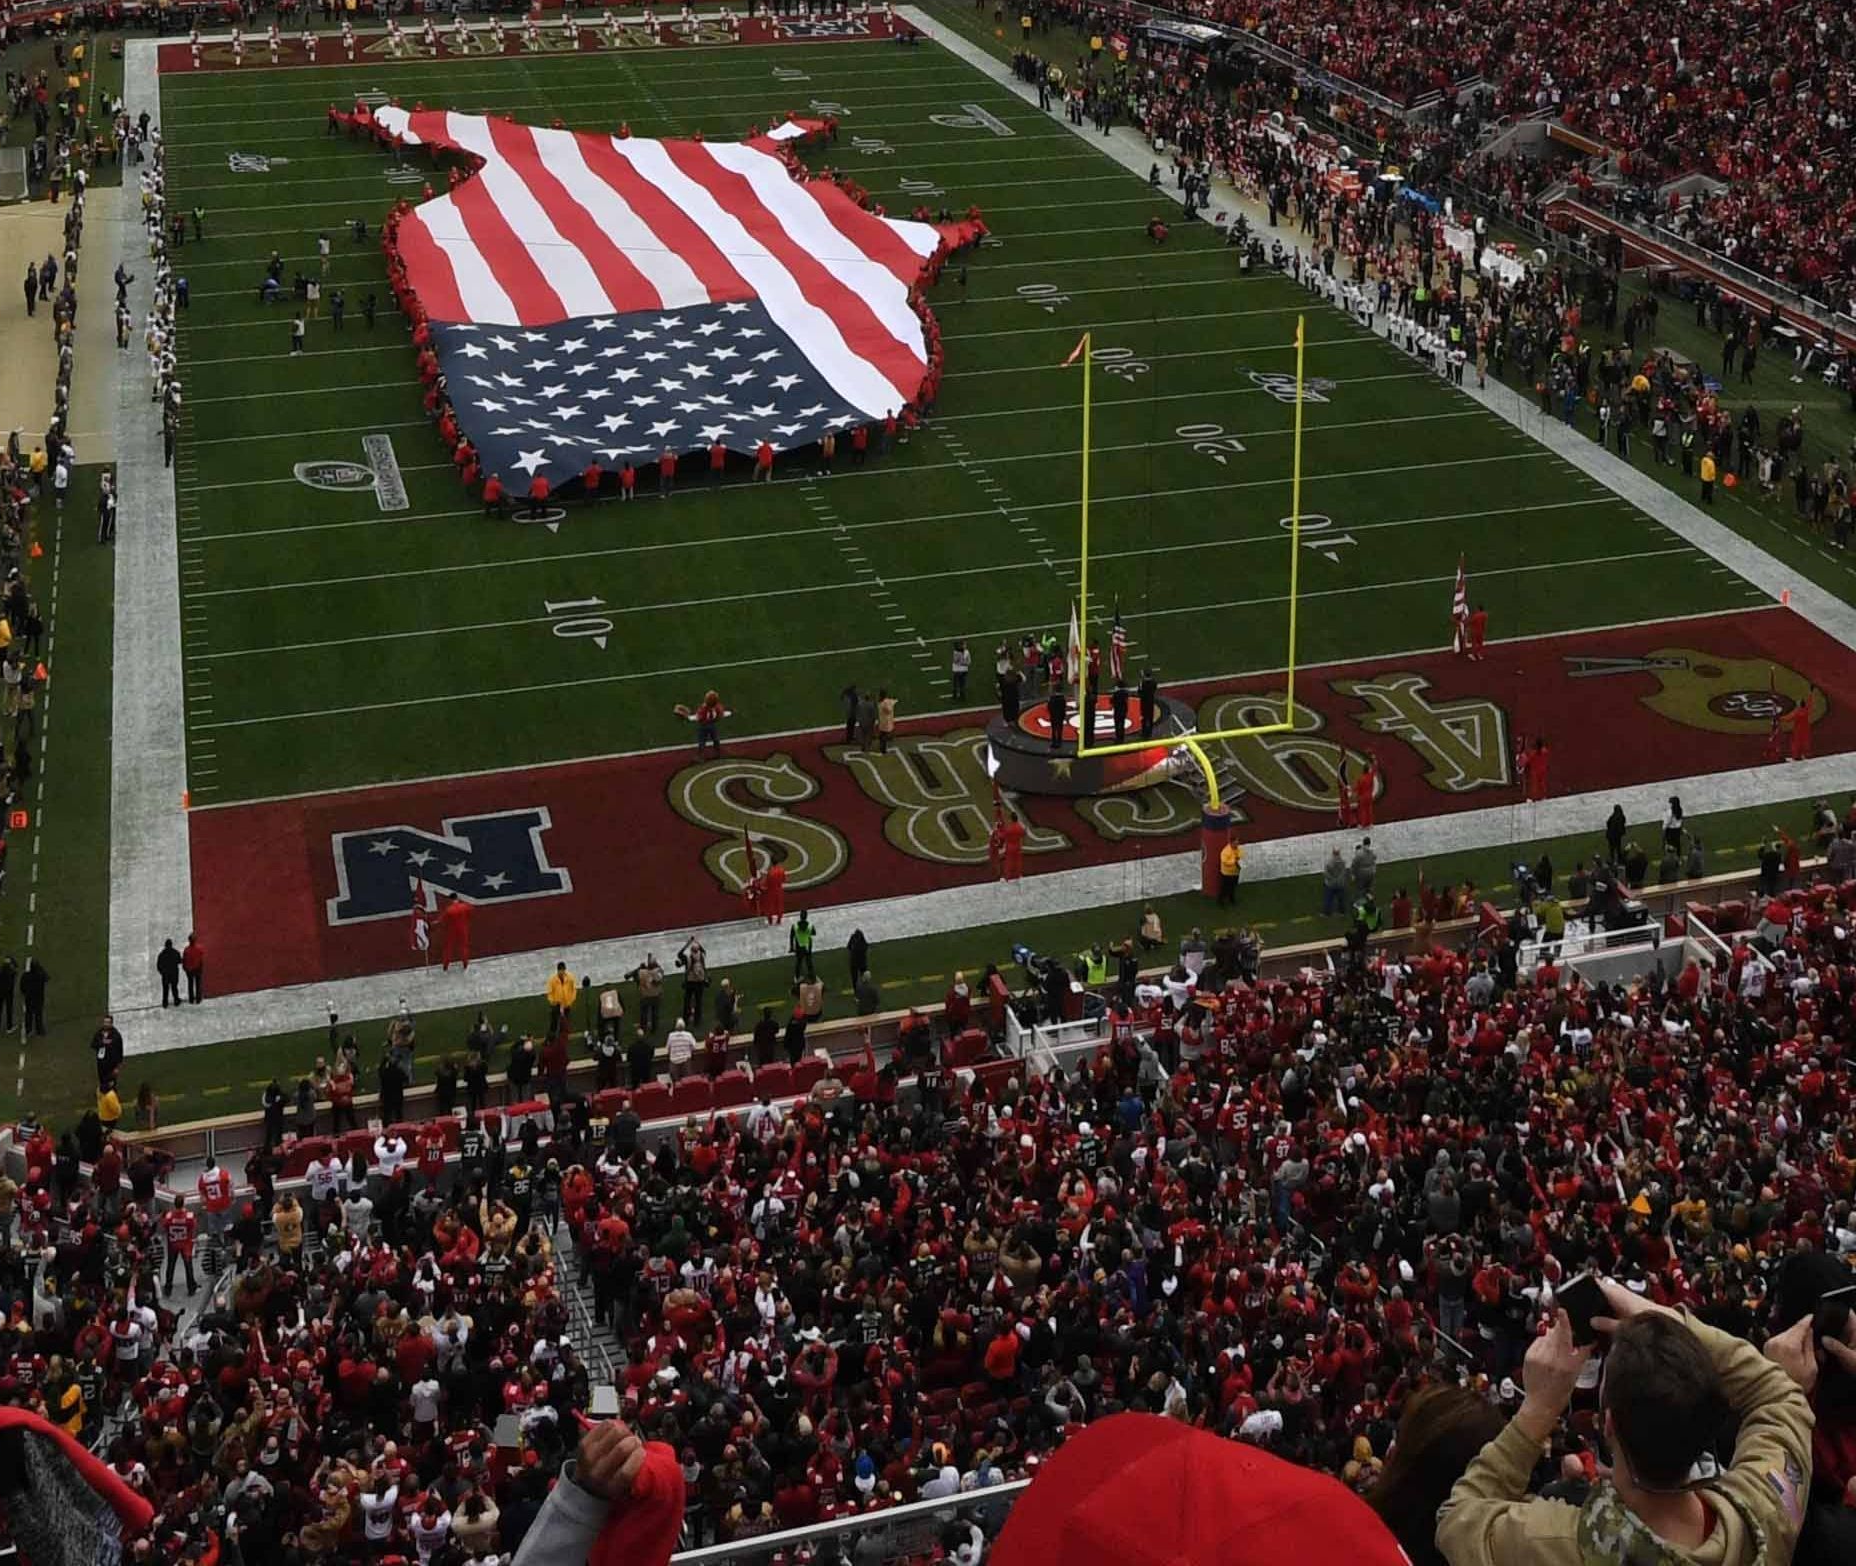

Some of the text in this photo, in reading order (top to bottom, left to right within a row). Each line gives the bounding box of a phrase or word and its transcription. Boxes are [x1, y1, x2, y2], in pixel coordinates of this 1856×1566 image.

[1088, 347, 1150, 375] 30
[1175, 423, 1246, 453] 20
[1279, 514, 1358, 550] 10
[544, 596, 614, 638] 10
